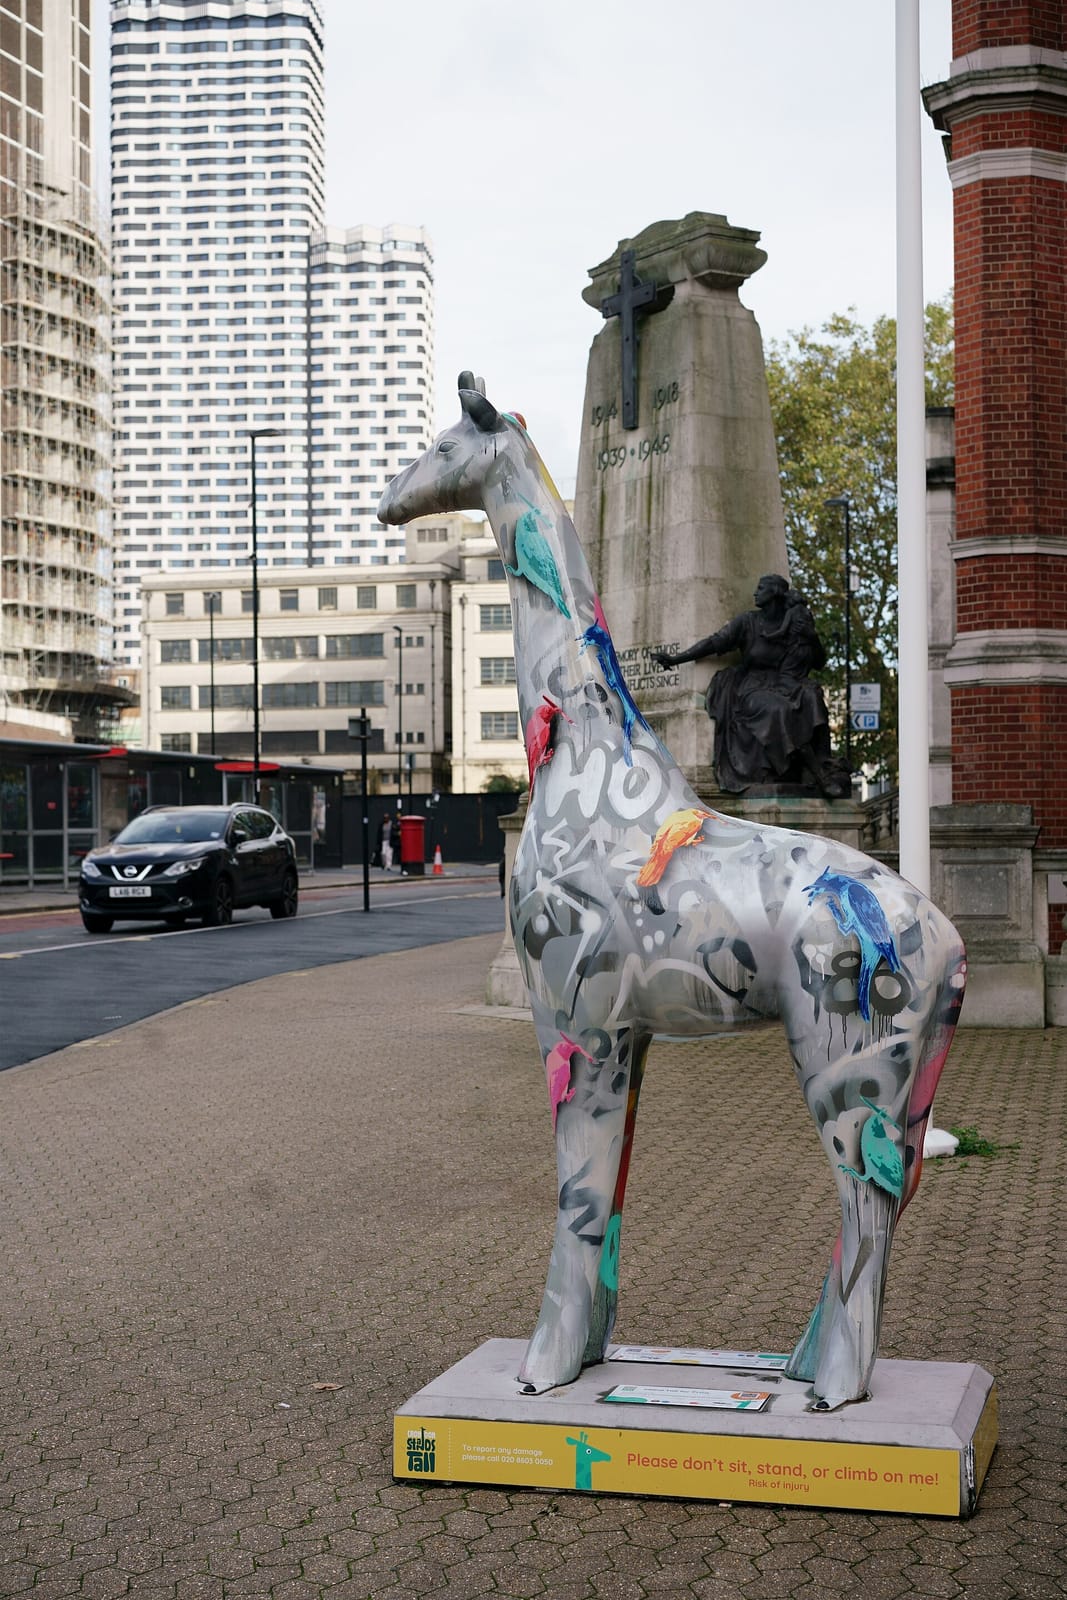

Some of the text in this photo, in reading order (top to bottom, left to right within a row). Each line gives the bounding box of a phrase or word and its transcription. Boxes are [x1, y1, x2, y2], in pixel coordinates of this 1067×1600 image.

[591, 381, 679, 428] 1914 1918
[597, 433, 671, 472] 1939 1945
[656, 674, 680, 688] SINCE
[463, 1444, 543, 1457] To report any damage
[462, 1454, 485, 1462] please
[487, 1454, 500, 1462] call
[501, 1455, 515, 1463] 020
[627, 1453, 939, 1486] Please don't sit, stand, or climb on me!
[748, 1479, 810, 1492] Risk of injury
